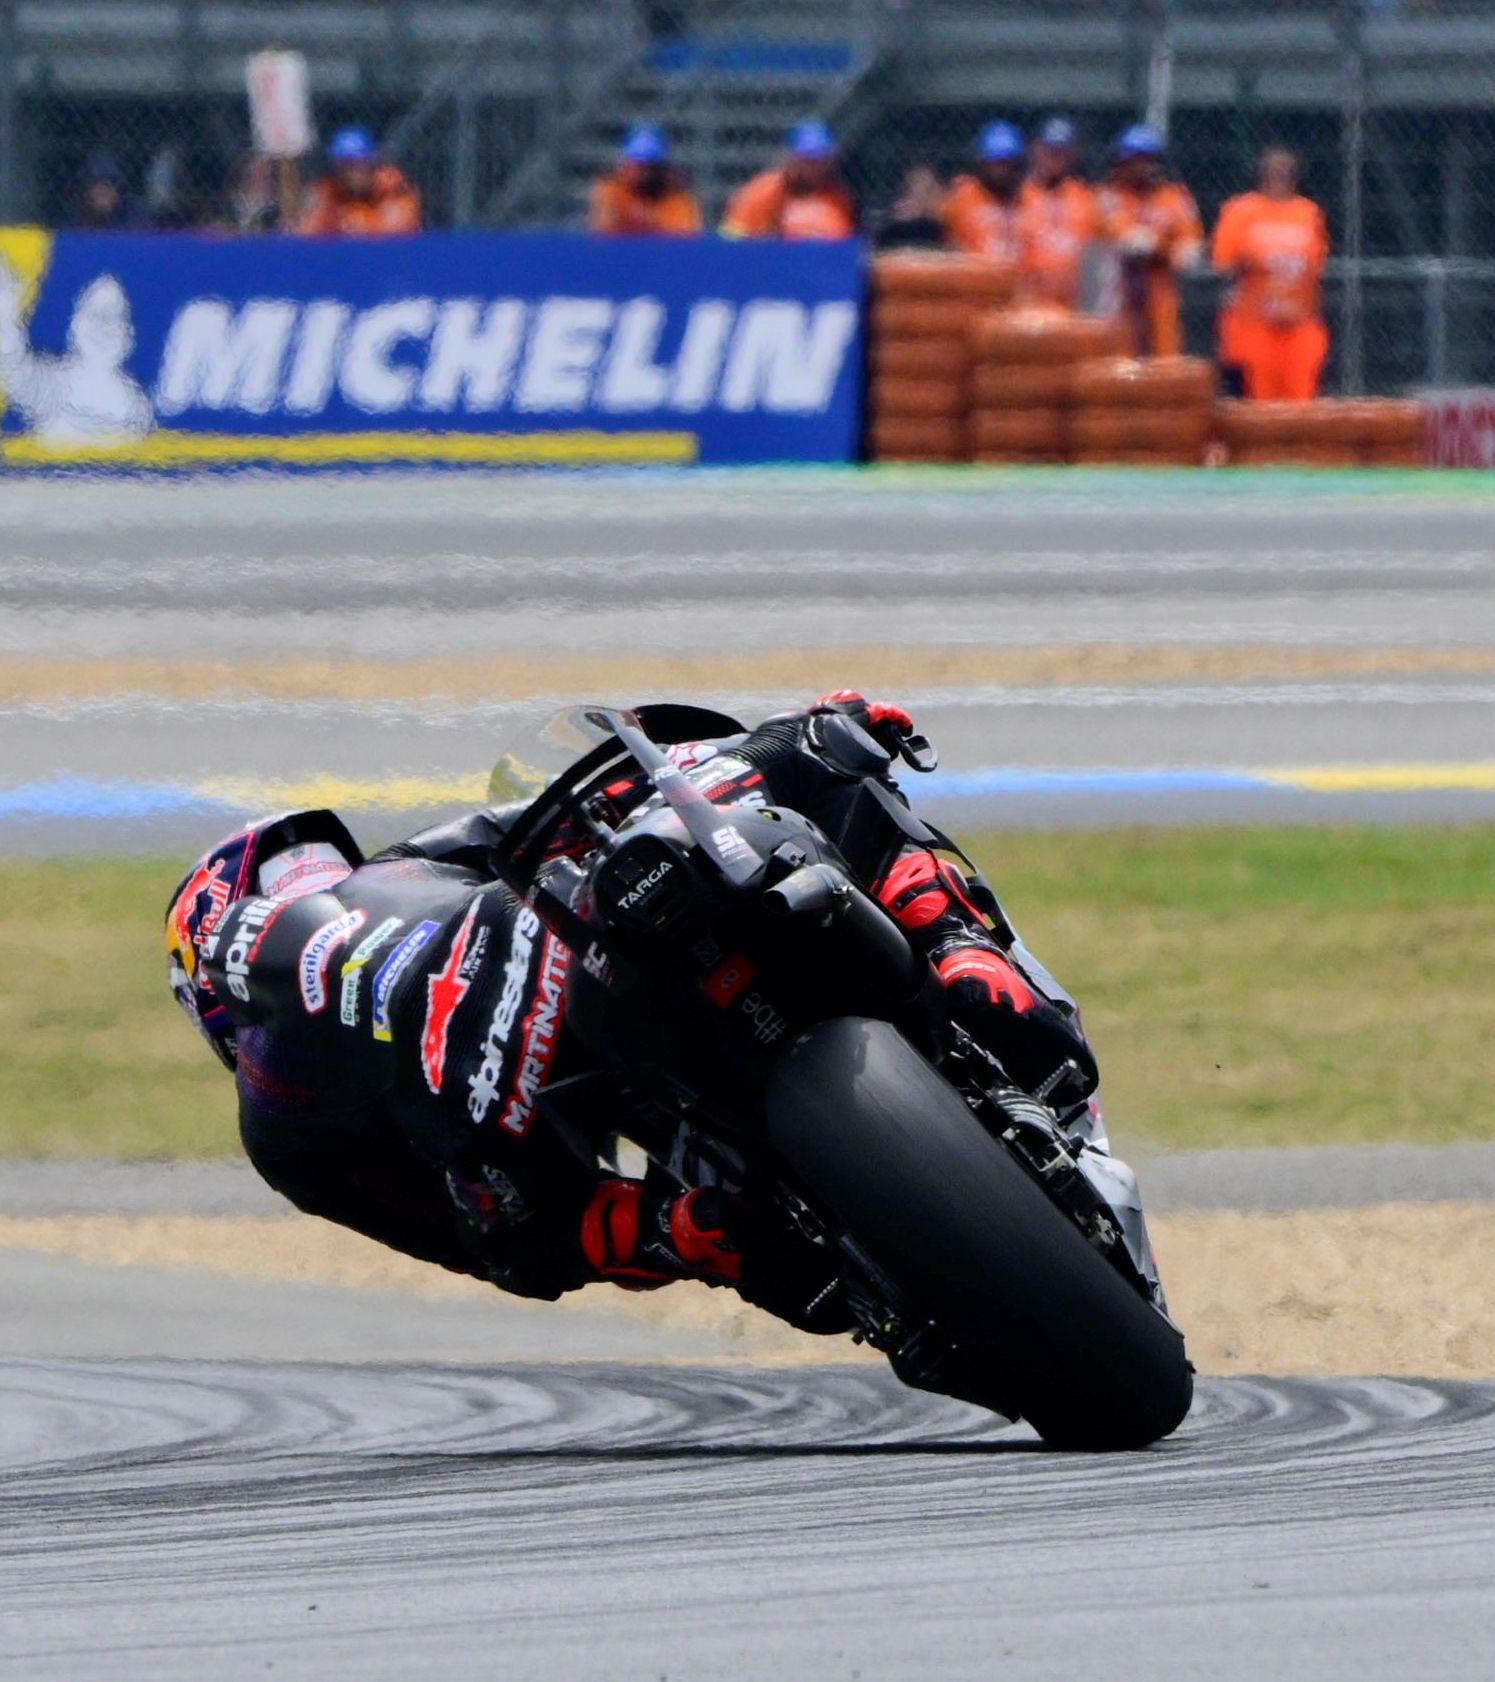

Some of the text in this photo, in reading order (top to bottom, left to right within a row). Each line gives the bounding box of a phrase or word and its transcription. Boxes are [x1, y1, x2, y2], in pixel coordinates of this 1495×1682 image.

[157, 295, 858, 414] MICHELIN
[617, 861, 673, 909] TARGA
[305, 915, 357, 1004] sterilgarda
[342, 979, 355, 1022] Green
[467, 906, 540, 1124] alpinestars
